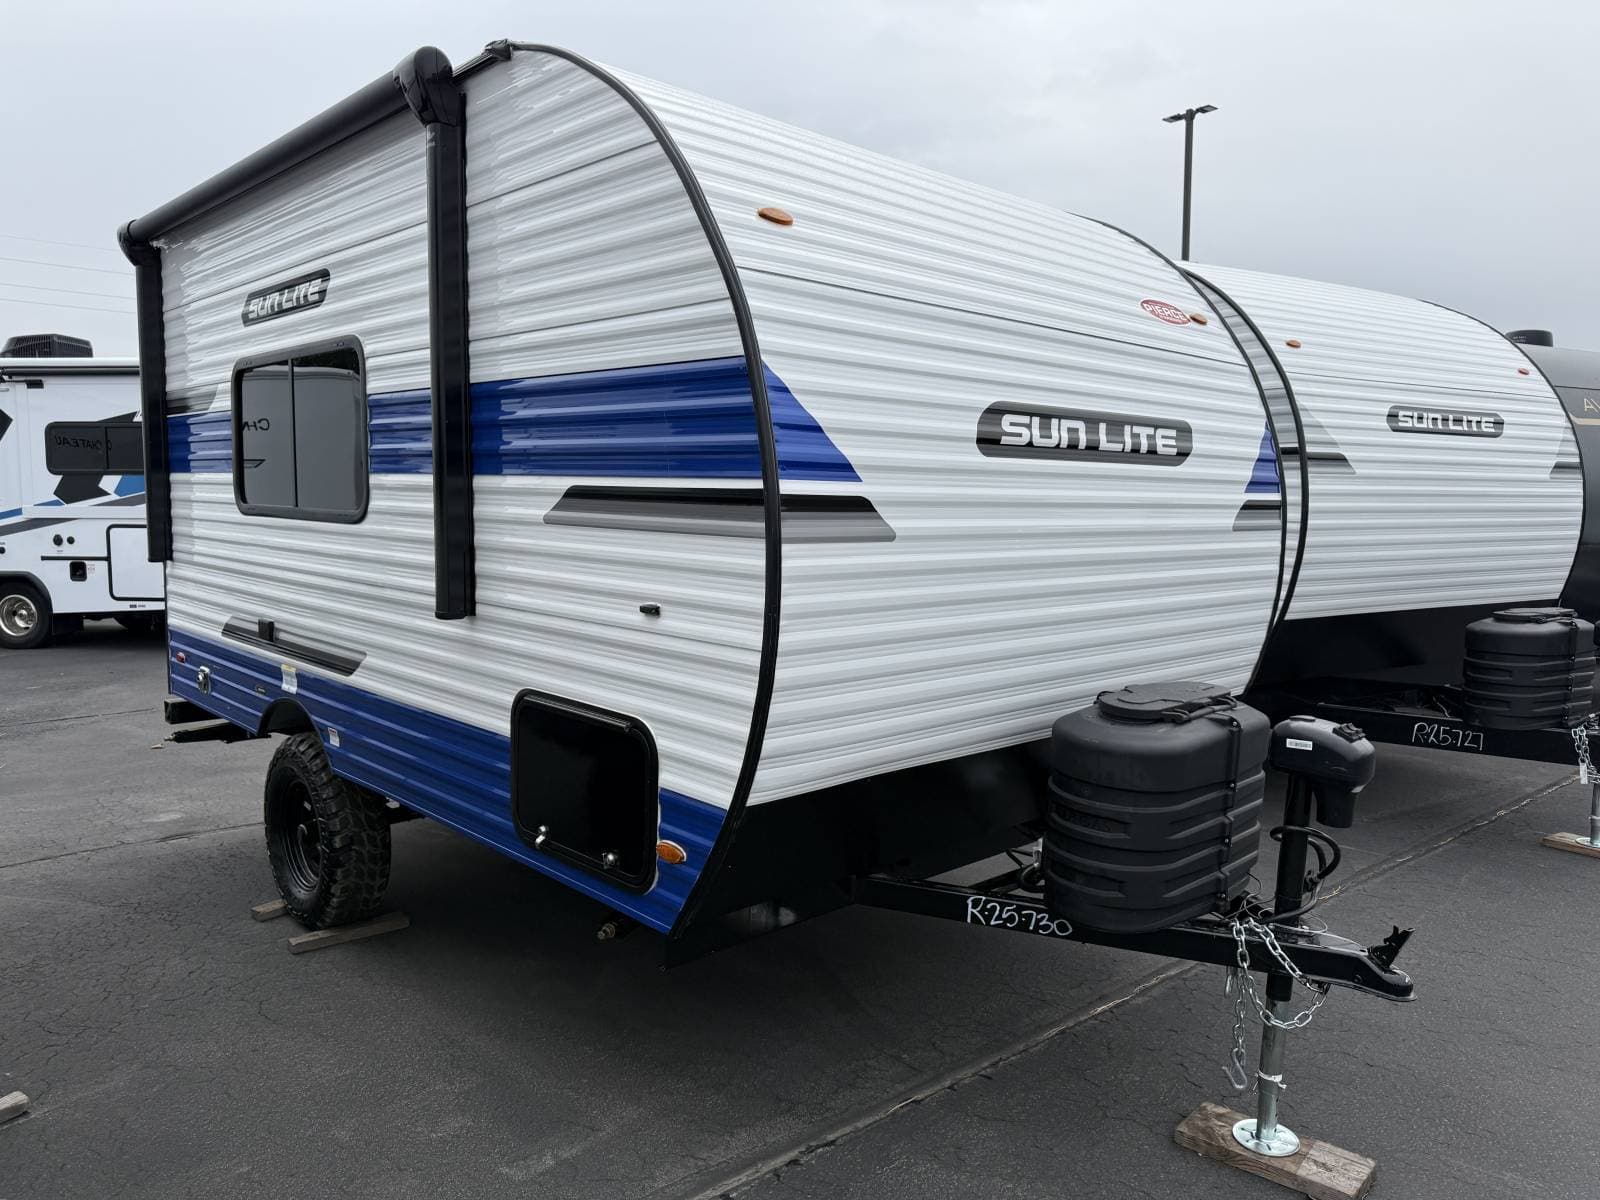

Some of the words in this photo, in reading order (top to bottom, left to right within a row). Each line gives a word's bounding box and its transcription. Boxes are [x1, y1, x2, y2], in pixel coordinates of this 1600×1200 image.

[248, 292, 280, 319] SUN
[282, 278, 322, 309] LITE
[1000, 413, 1087, 450] SUN
[1098, 422, 1178, 456] LITE
[1398, 410, 1443, 429] SUN
[1448, 414, 1495, 432] LITE
